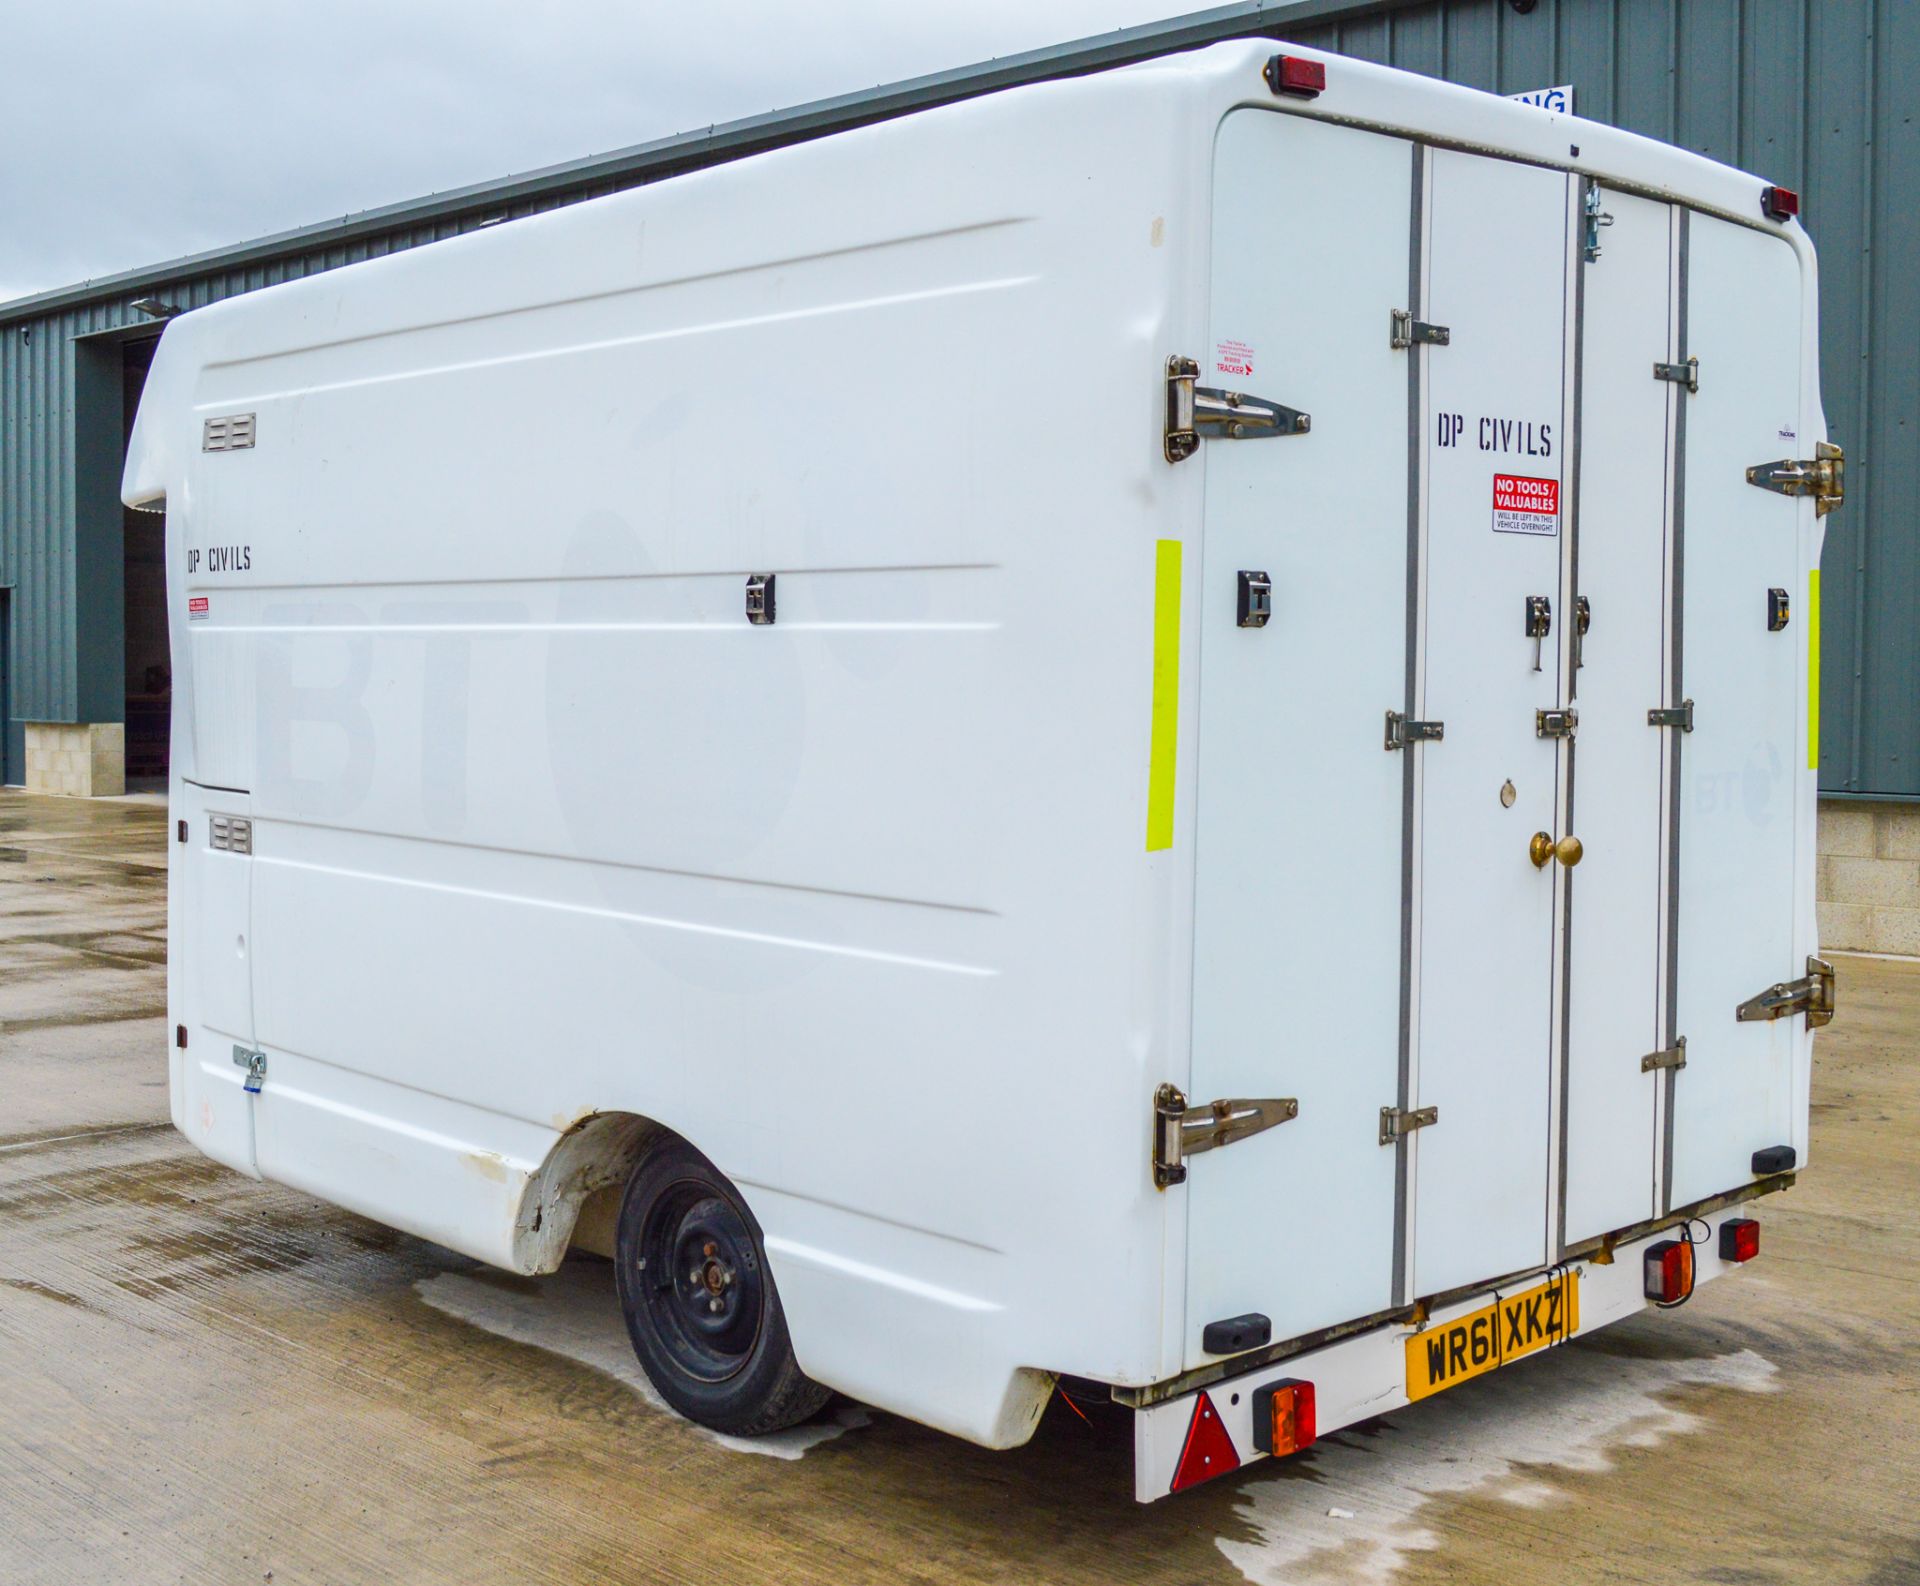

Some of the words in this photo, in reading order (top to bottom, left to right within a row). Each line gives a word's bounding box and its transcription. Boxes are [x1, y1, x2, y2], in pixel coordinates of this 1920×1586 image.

[1438, 412, 1463, 448] DP
[1480, 417, 1551, 457] CIVILS
[1496, 479, 1514, 493] NO
[1496, 493, 1555, 512] VALUABLES
[1497, 511, 1511, 520] WILL
[1512, 512, 1519, 520] BE
[1520, 513, 1532, 522] LEFT
[1533, 514, 1540, 522] IN
[1541, 515, 1553, 524] THIS
[1497, 520, 1520, 530] VEHICLE
[1521, 522, 1553, 532] OVERNIGHT
[188, 549, 200, 573] DP
[208, 545, 251, 572] CIVILS
[1427, 1312, 1497, 1386] WR61
[1506, 1286, 1562, 1352] XKZ
